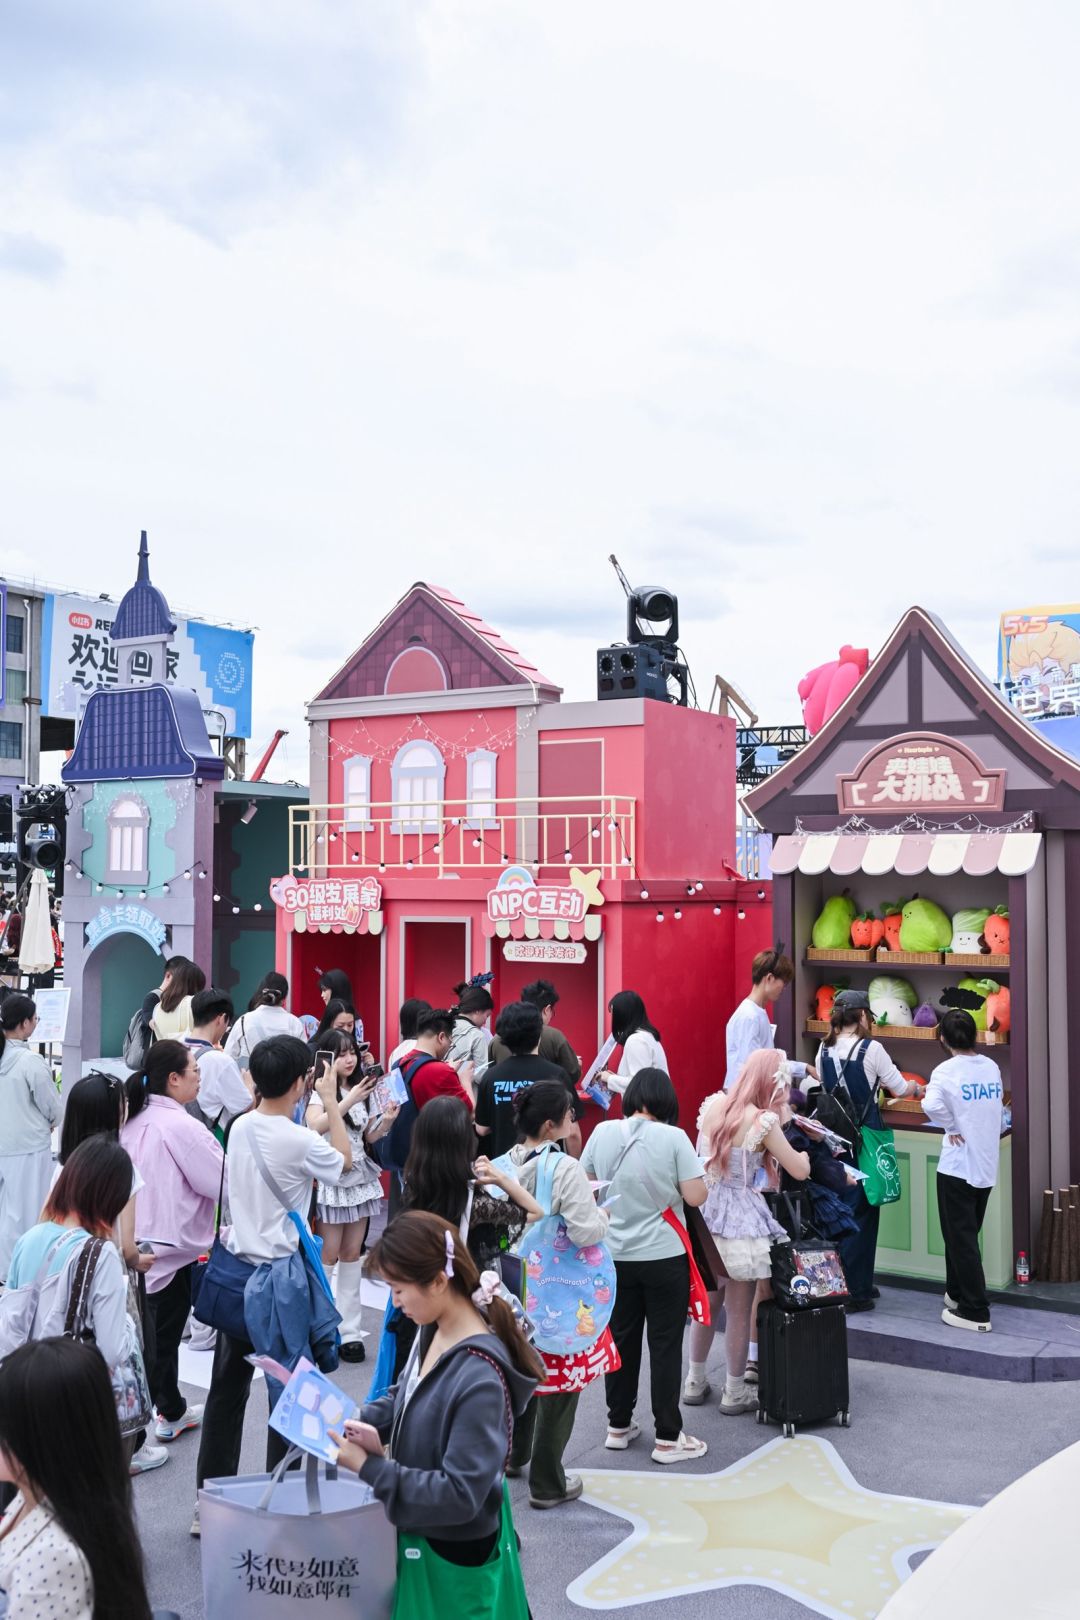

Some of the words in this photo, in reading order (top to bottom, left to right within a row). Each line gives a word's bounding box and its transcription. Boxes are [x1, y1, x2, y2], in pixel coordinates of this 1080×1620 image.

[884, 756, 954, 776] 夹娃娃
[872, 774, 966, 802] 大挑战
[310, 905, 348, 921] 福利处
[491, 891, 581, 917] NPC互动
[514, 945, 577, 960] 欢迎打卡发布
[961, 1083, 1002, 1101] STAFF
[246, 1574, 360, 1600] 找如意郎君
